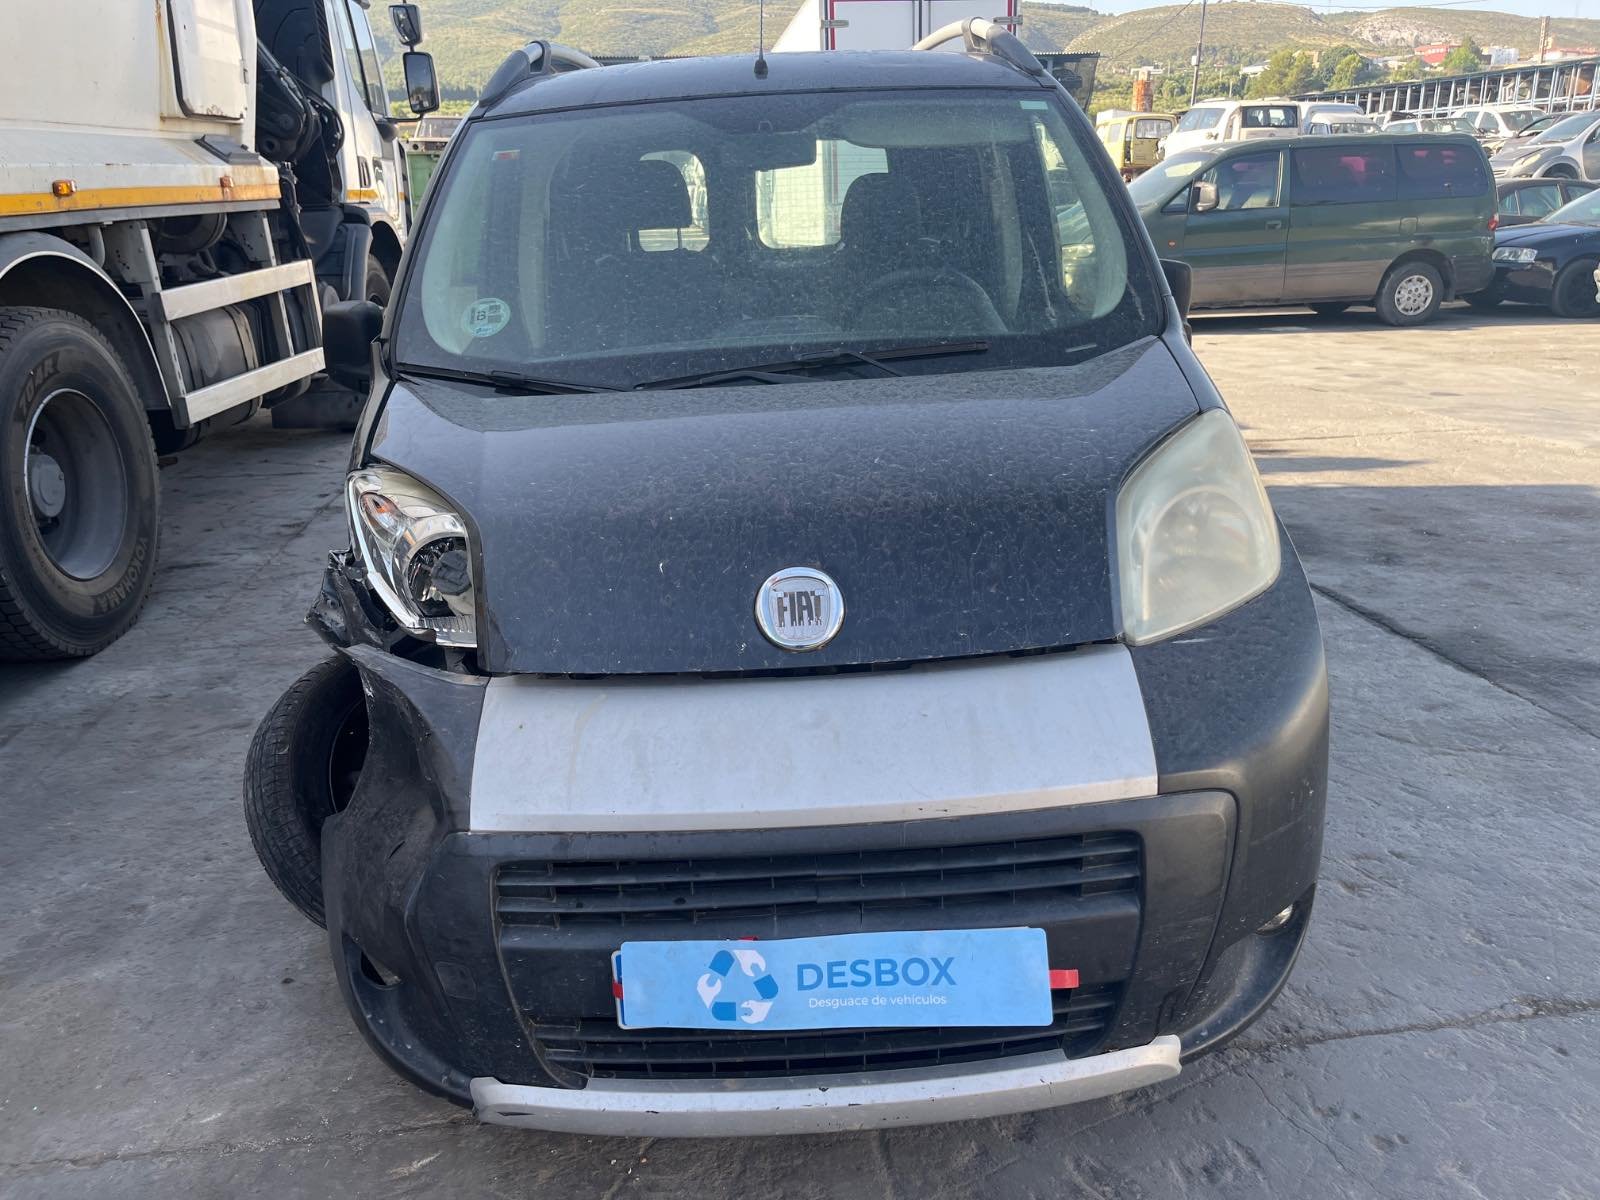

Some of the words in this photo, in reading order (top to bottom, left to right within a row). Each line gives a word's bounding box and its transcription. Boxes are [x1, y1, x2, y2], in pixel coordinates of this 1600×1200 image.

[96, 536, 149, 613] YOKOHAMA
[776, 589, 825, 628] FIAT
[797, 957, 957, 991] DESBOX
[808, 996, 869, 1009] Desguace
[871, 994, 887, 1006] de
